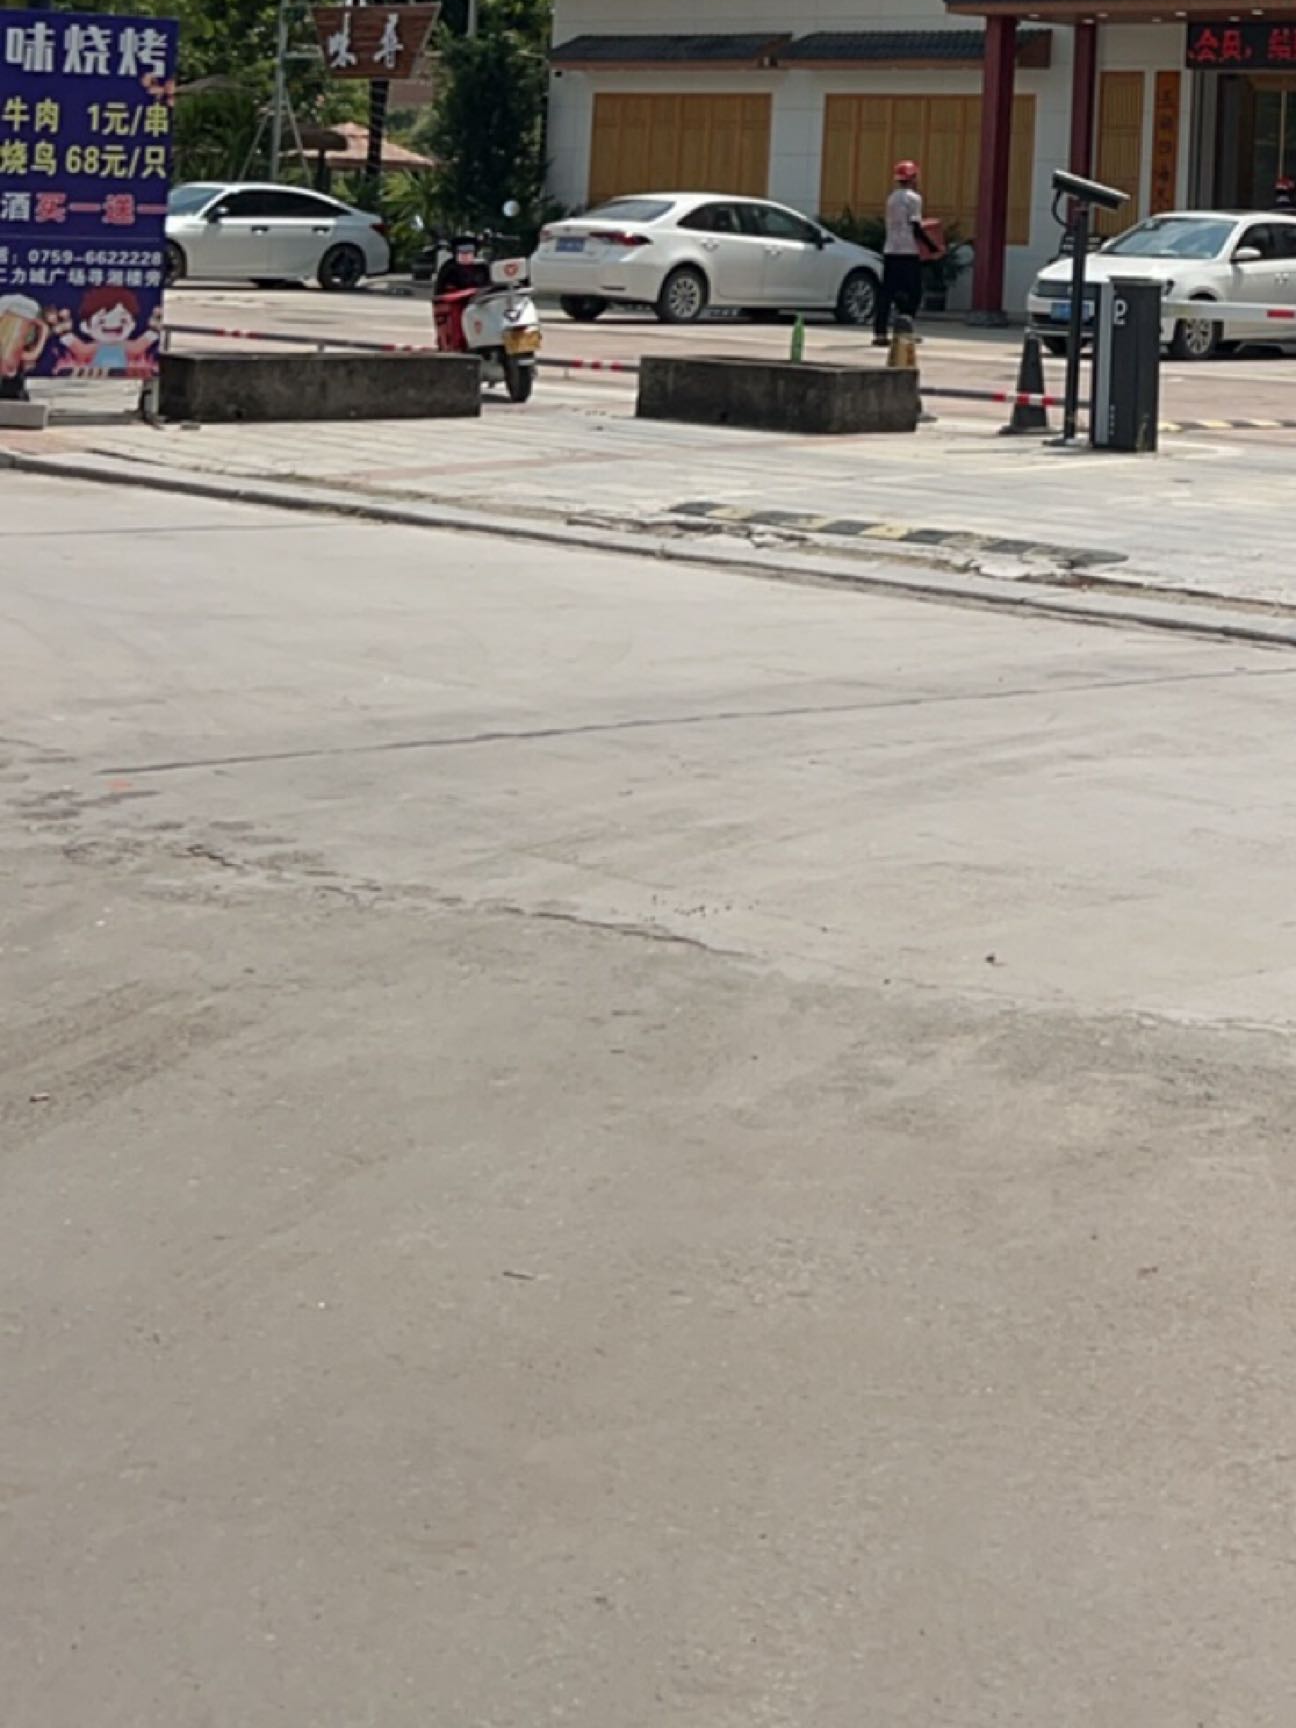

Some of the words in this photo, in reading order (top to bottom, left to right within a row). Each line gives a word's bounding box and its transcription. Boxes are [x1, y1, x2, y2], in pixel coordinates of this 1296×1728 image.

[6, 22, 168, 78] 味烧烤
[2, 96, 60, 133] 牛肉
[87, 103, 169, 137] 1元/串
[65, 144, 167, 179] 68元/只
